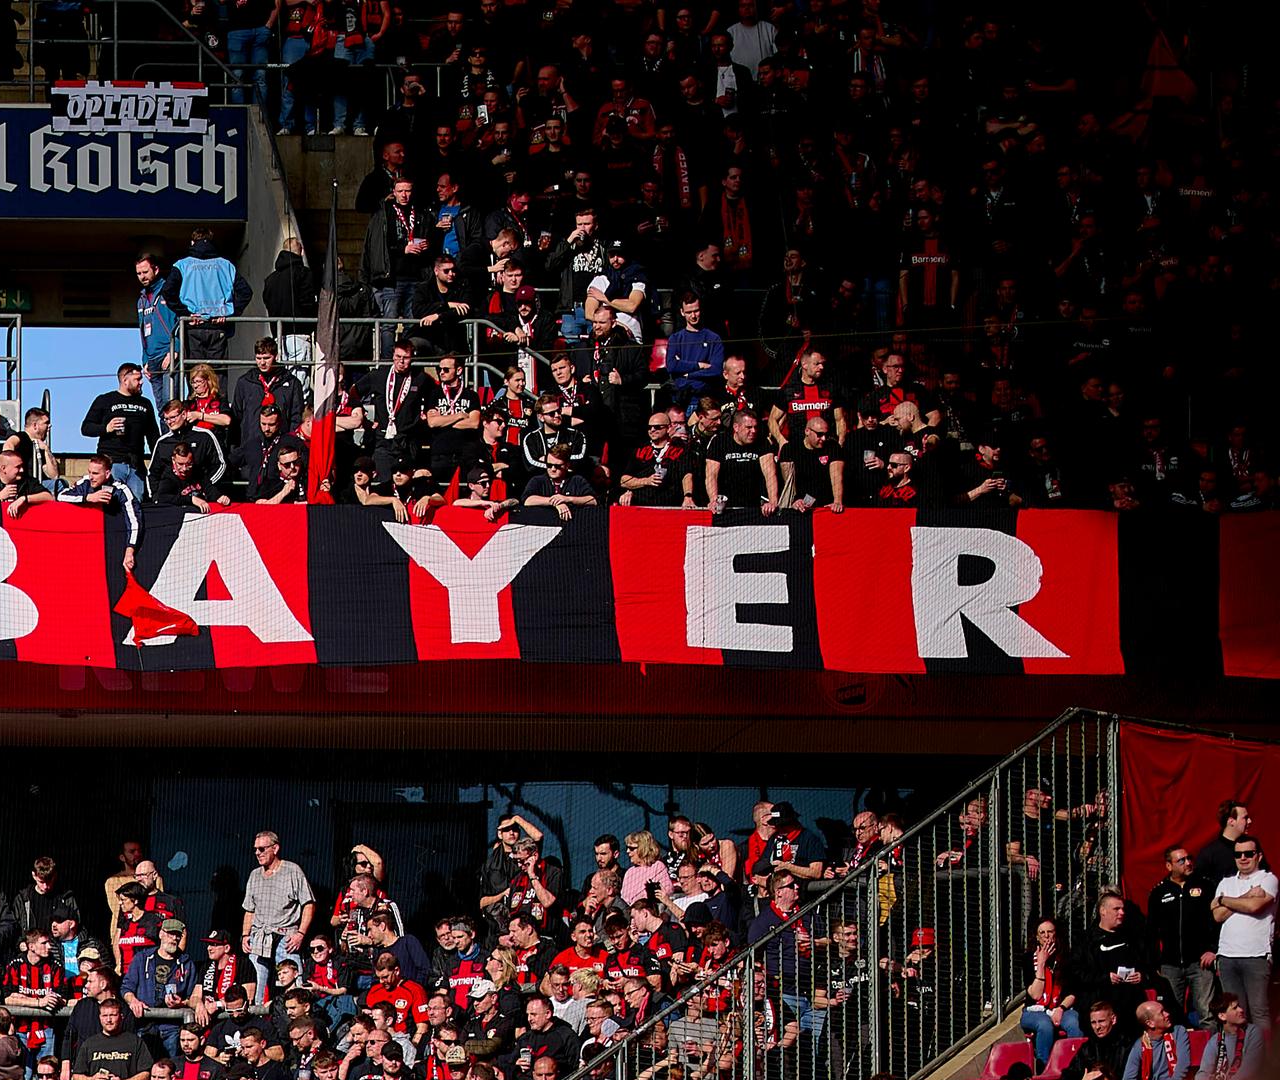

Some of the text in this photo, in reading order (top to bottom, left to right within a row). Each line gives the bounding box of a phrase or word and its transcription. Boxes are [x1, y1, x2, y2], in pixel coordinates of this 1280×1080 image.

[66, 95, 193, 120] OPLADEN
[912, 254, 948, 265] Barmeni
[792, 401, 831, 412] Barmeni
[119, 934, 145, 945] rmenia
[92, 1051, 134, 1062] LiveFast
